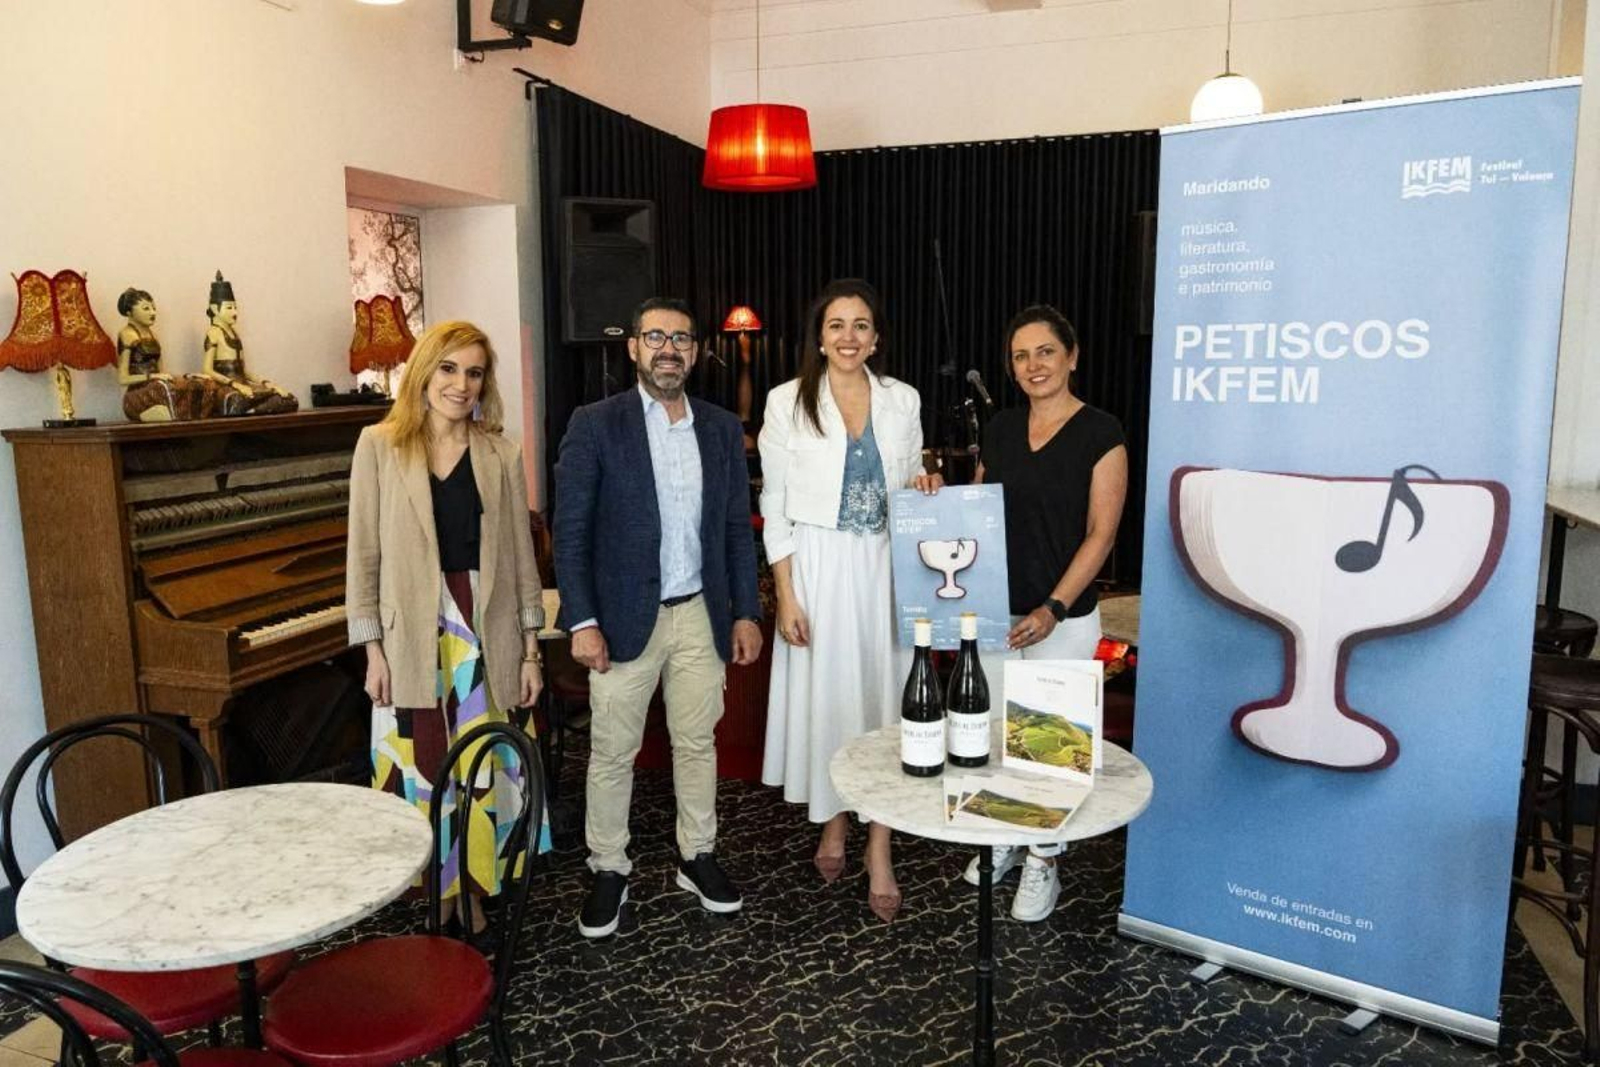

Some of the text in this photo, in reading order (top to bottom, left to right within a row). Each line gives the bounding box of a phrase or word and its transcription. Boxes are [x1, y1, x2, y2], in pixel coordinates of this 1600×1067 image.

[1402, 155, 1472, 186] IKFEM
[1480, 159, 1523, 172] Festival
[1183, 176, 1271, 197] Maridando
[1179, 240, 1250, 256] literatura,
[1178, 258, 1275, 278] gastronomía
[1178, 277, 1272, 298] e patrimonio
[1174, 318, 1431, 361] PETISCOS
[1171, 366, 1320, 404] IKFEM
[1226, 881, 1374, 931] Venda de entradas en
[1243, 904, 1357, 944] www.ikfem.com
